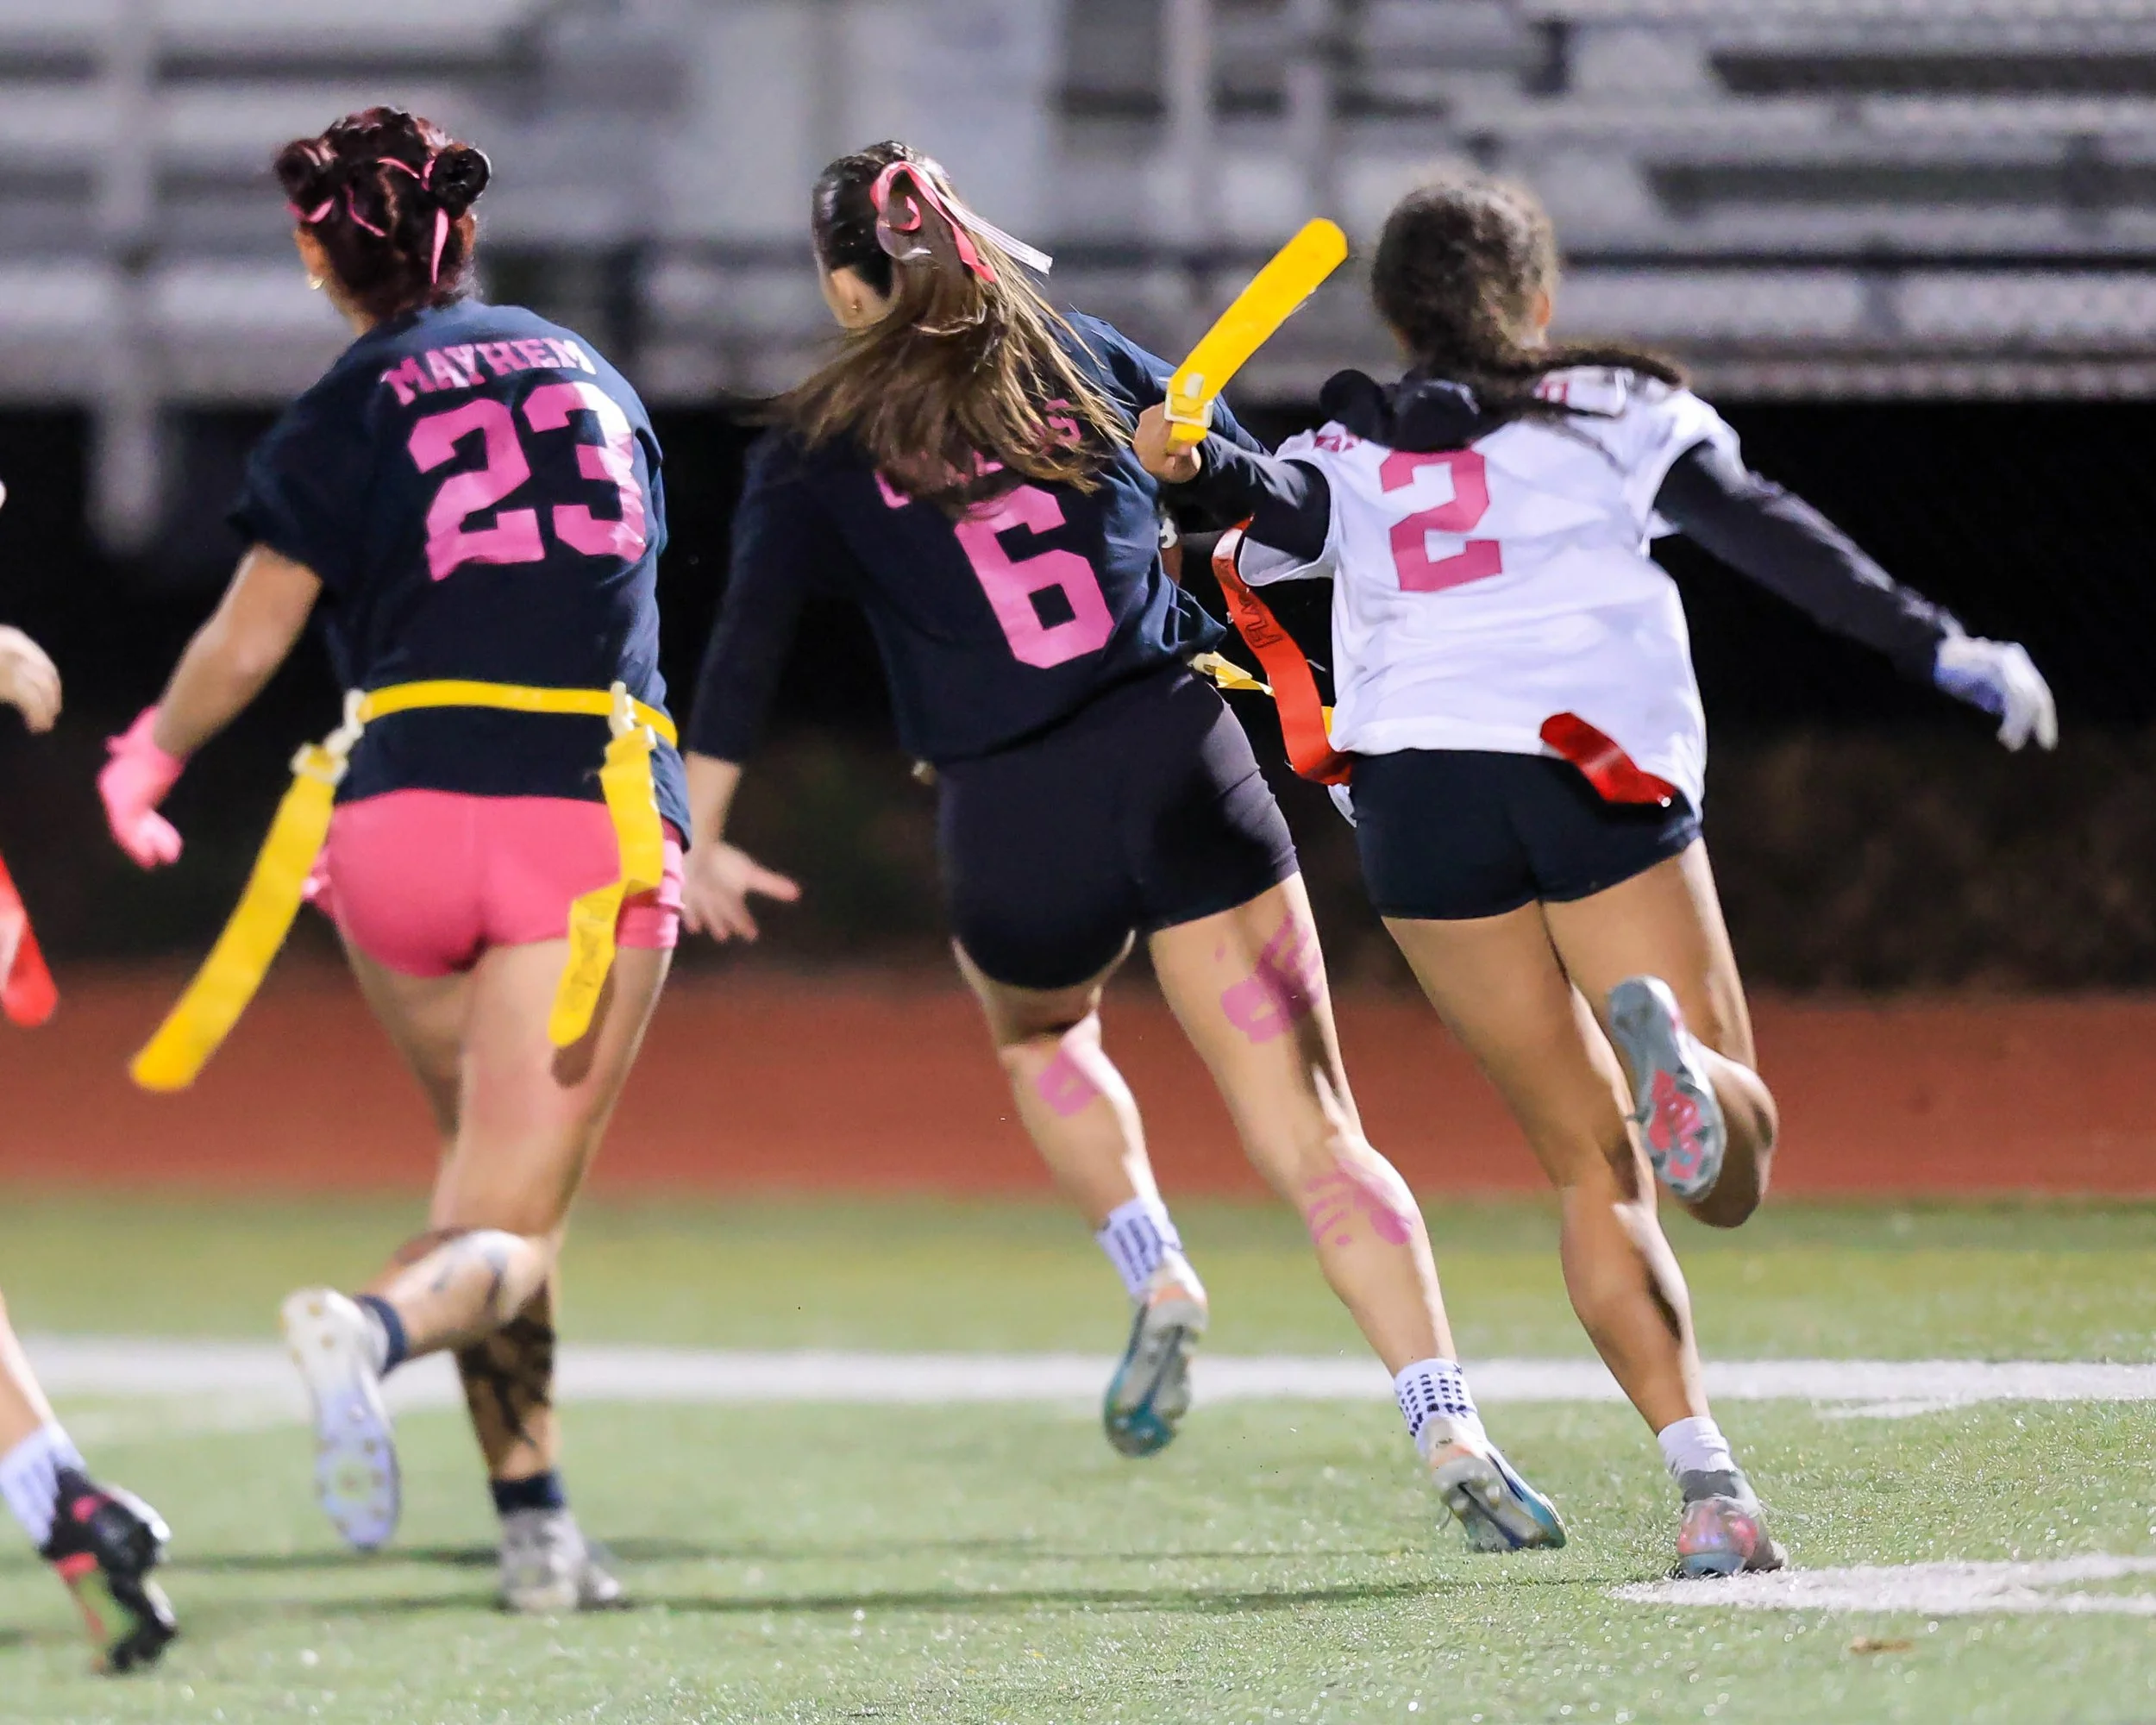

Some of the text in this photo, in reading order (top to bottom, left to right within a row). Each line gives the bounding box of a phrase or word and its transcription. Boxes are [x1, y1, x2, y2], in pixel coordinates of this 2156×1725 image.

[380, 337, 598, 406] MAYHEM
[407, 381, 646, 582] 23
[1379, 448, 1501, 593] 2
[954, 484, 1114, 669] 6
